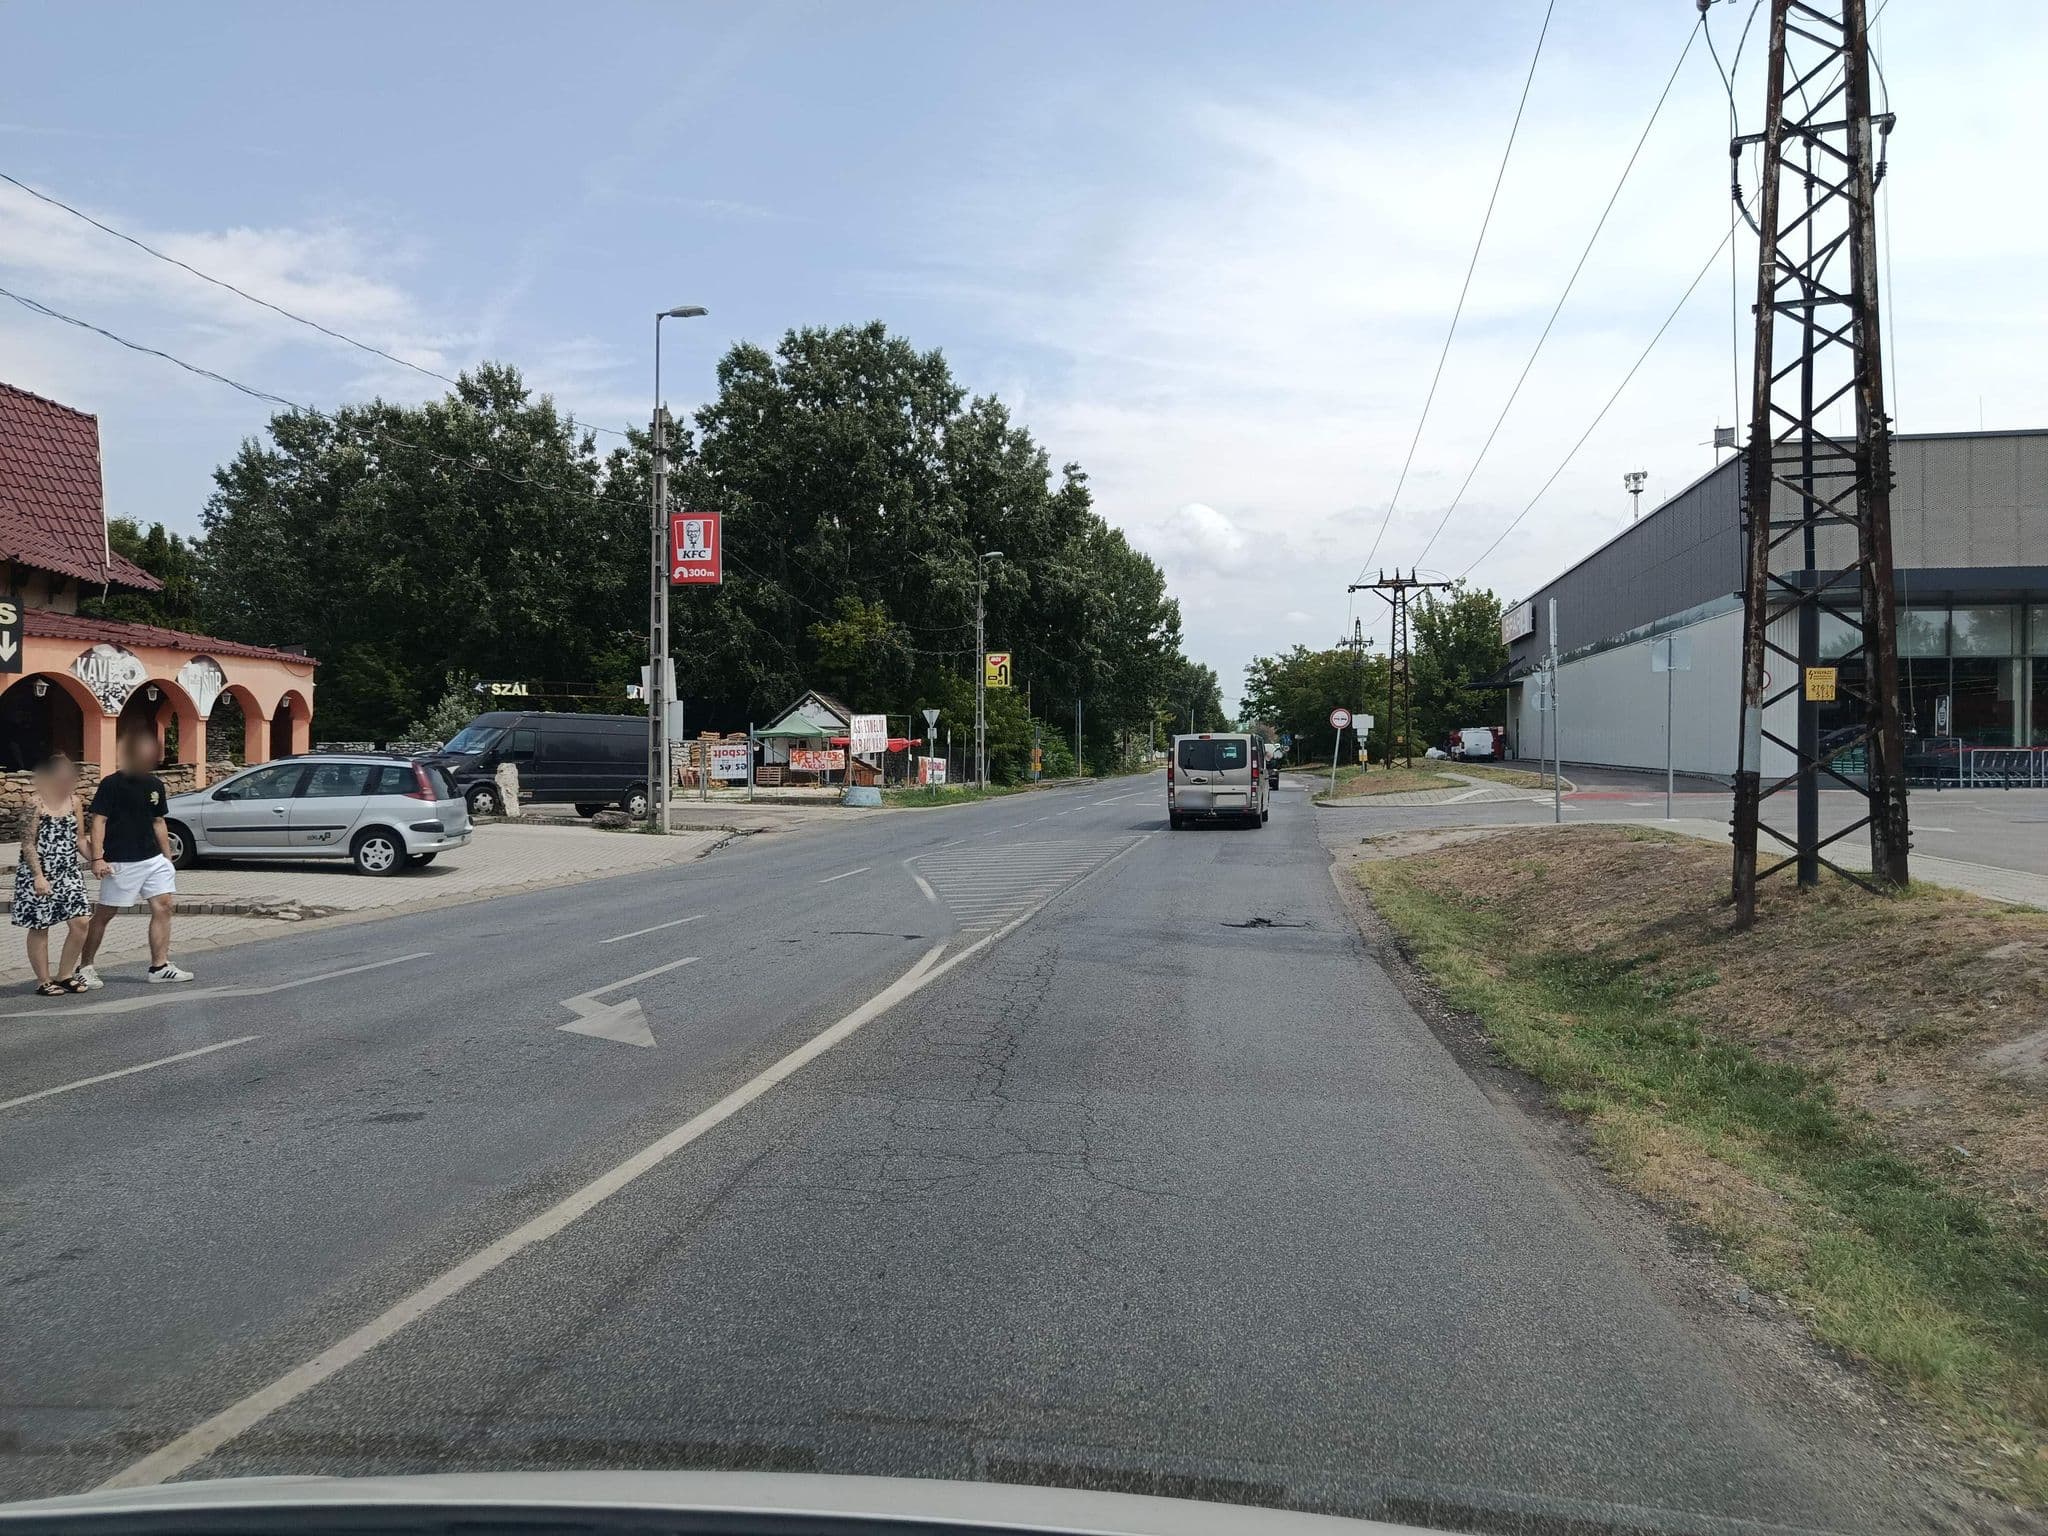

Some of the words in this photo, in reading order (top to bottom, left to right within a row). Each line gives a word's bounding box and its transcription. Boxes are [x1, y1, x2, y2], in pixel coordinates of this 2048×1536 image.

[682, 550, 706, 559] KFC
[688, 569, 715, 577] 300m
[491, 682, 529, 696] SZÁL
